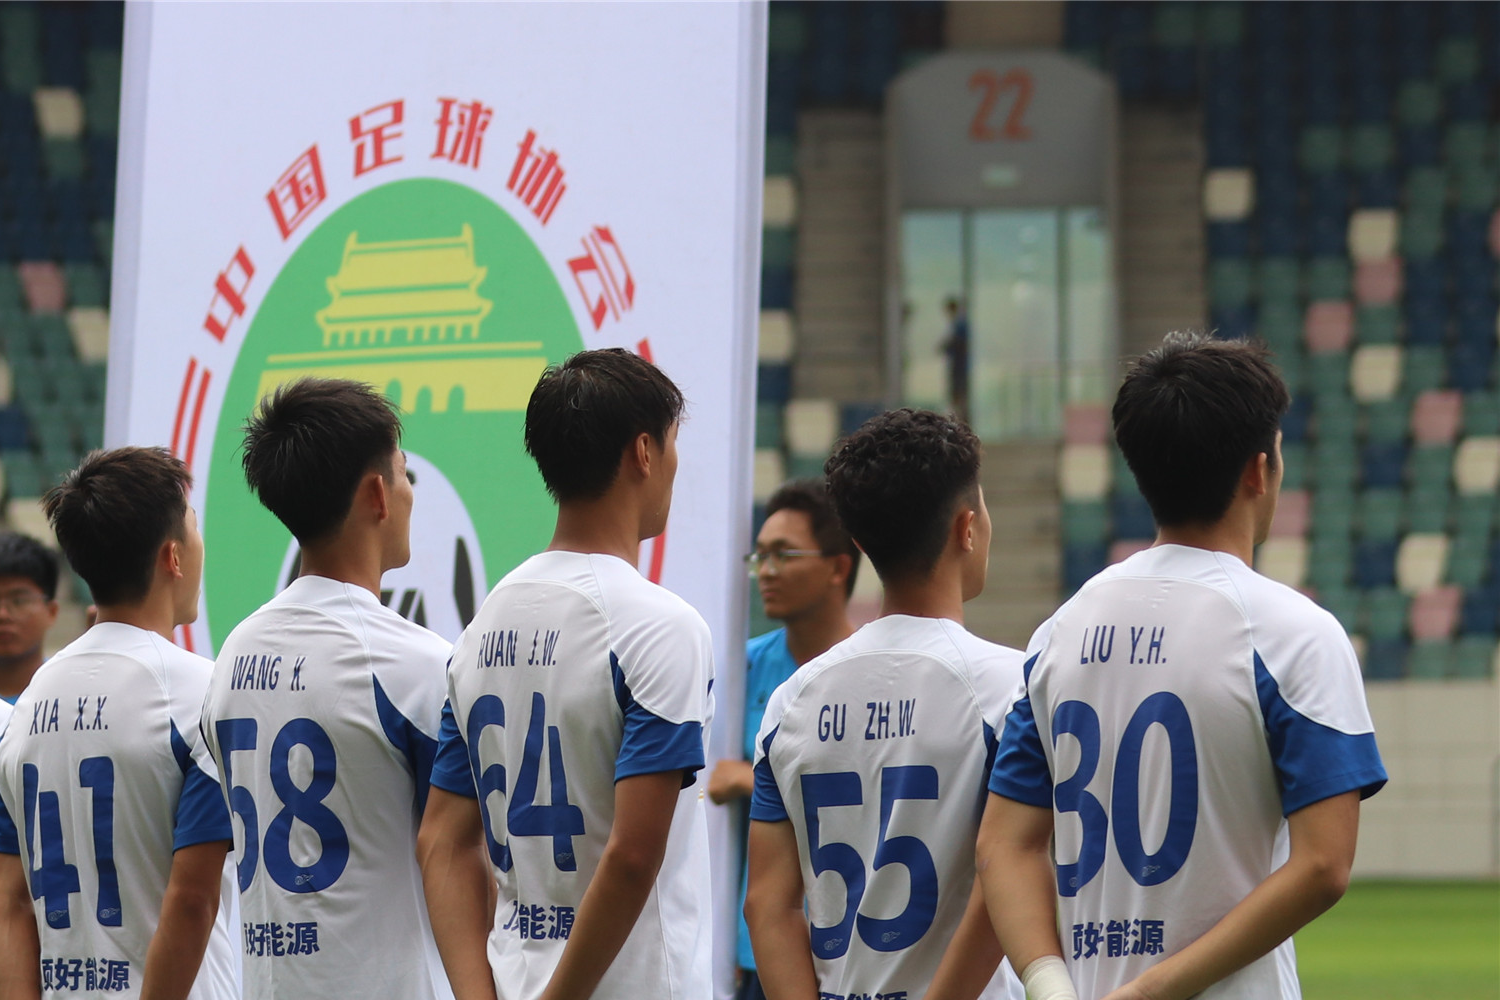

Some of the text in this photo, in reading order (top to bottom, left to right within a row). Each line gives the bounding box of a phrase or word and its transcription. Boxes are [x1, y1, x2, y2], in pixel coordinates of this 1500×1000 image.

[967, 68, 1035, 142] 22
[203, 97, 635, 344] 中国足球协会
[29, 696, 109, 736] XIA X.X.
[231, 654, 282, 691] WANG
[818, 698, 916, 742] GU ZH.W.
[1080, 625, 1167, 664] LIU Y.H.
[23, 756, 123, 930] 41
[215, 717, 350, 895] 58
[467, 691, 586, 874] 64
[800, 765, 939, 960] 55
[1052, 692, 1198, 897] 30
